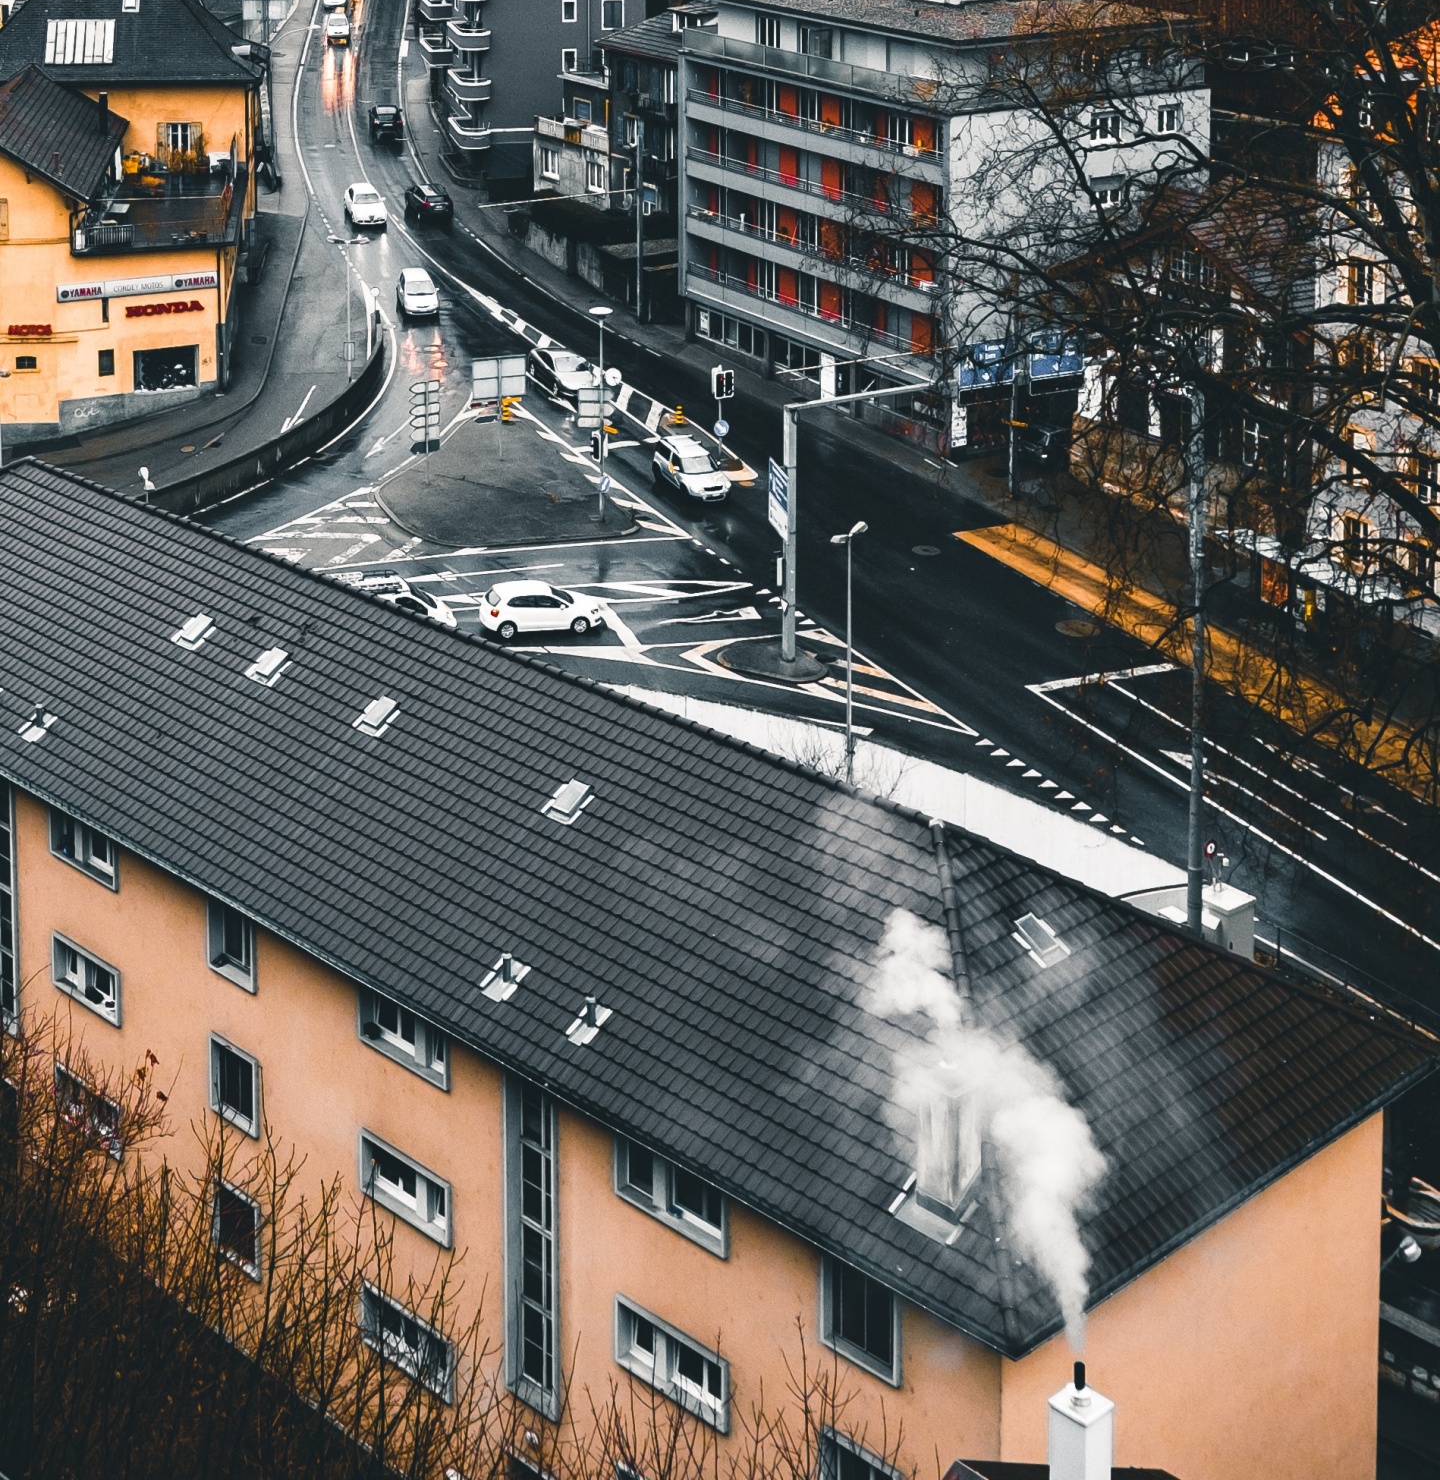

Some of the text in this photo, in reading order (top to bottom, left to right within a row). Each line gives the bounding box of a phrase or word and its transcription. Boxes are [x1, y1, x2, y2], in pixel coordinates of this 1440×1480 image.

[141, 281, 164, 290] MOTOS
[183, 275, 215, 287] YAMAHA
[69, 286, 102, 297] YAMAHA
[125, 300, 205, 318] HONDA
[8, 324, 53, 336] MOTOS
